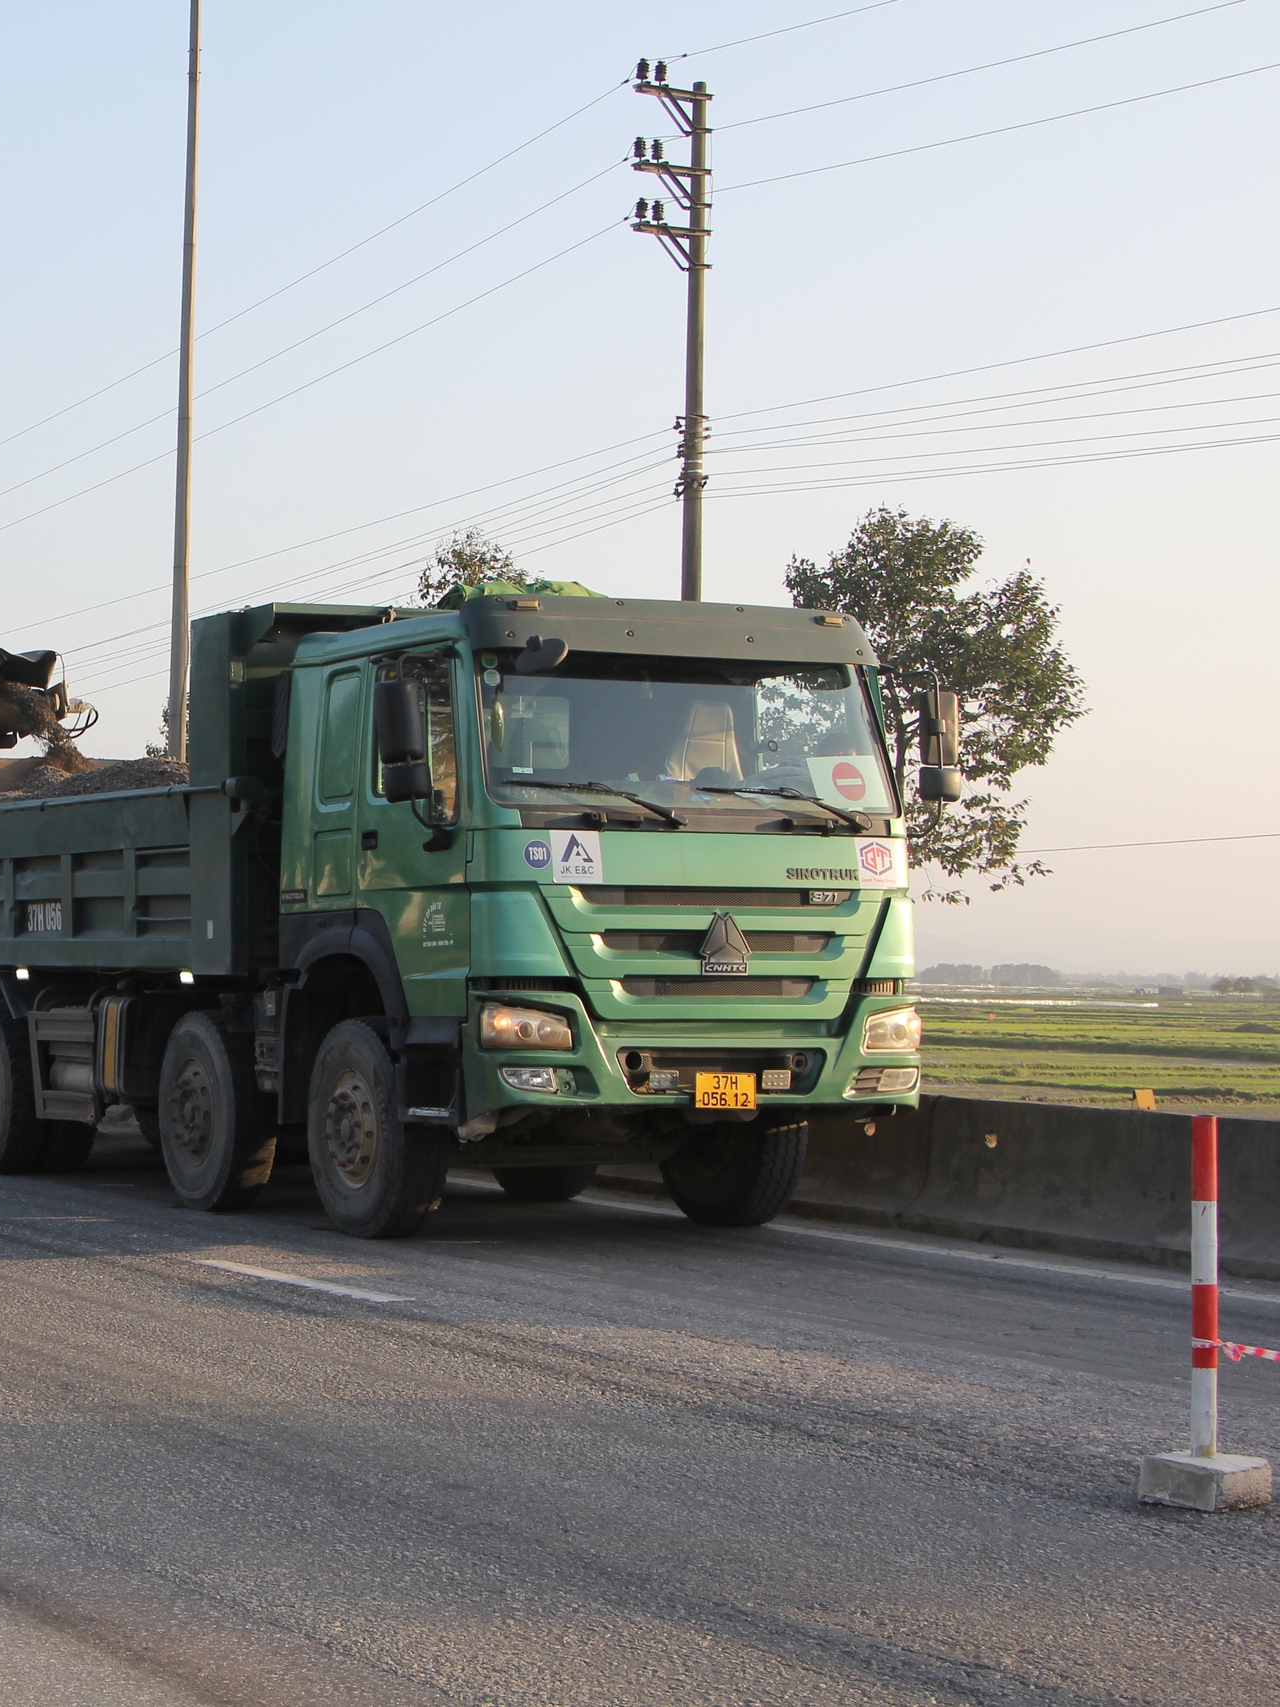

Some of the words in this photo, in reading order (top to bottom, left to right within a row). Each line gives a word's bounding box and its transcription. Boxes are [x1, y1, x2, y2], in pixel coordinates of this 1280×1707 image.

[528, 846, 547, 860] TS01
[560, 866, 572, 874] JK
[575, 866, 594, 874] E&C
[786, 867, 859, 881] SINOTRUK
[810, 891, 838, 902] 371
[28, 904, 44, 931] 37H
[46, 903, 62, 930] 056
[705, 963, 746, 972] CNHTC
[712, 1075, 738, 1090] 37H
[702, 1092, 749, 1107] 056.12
